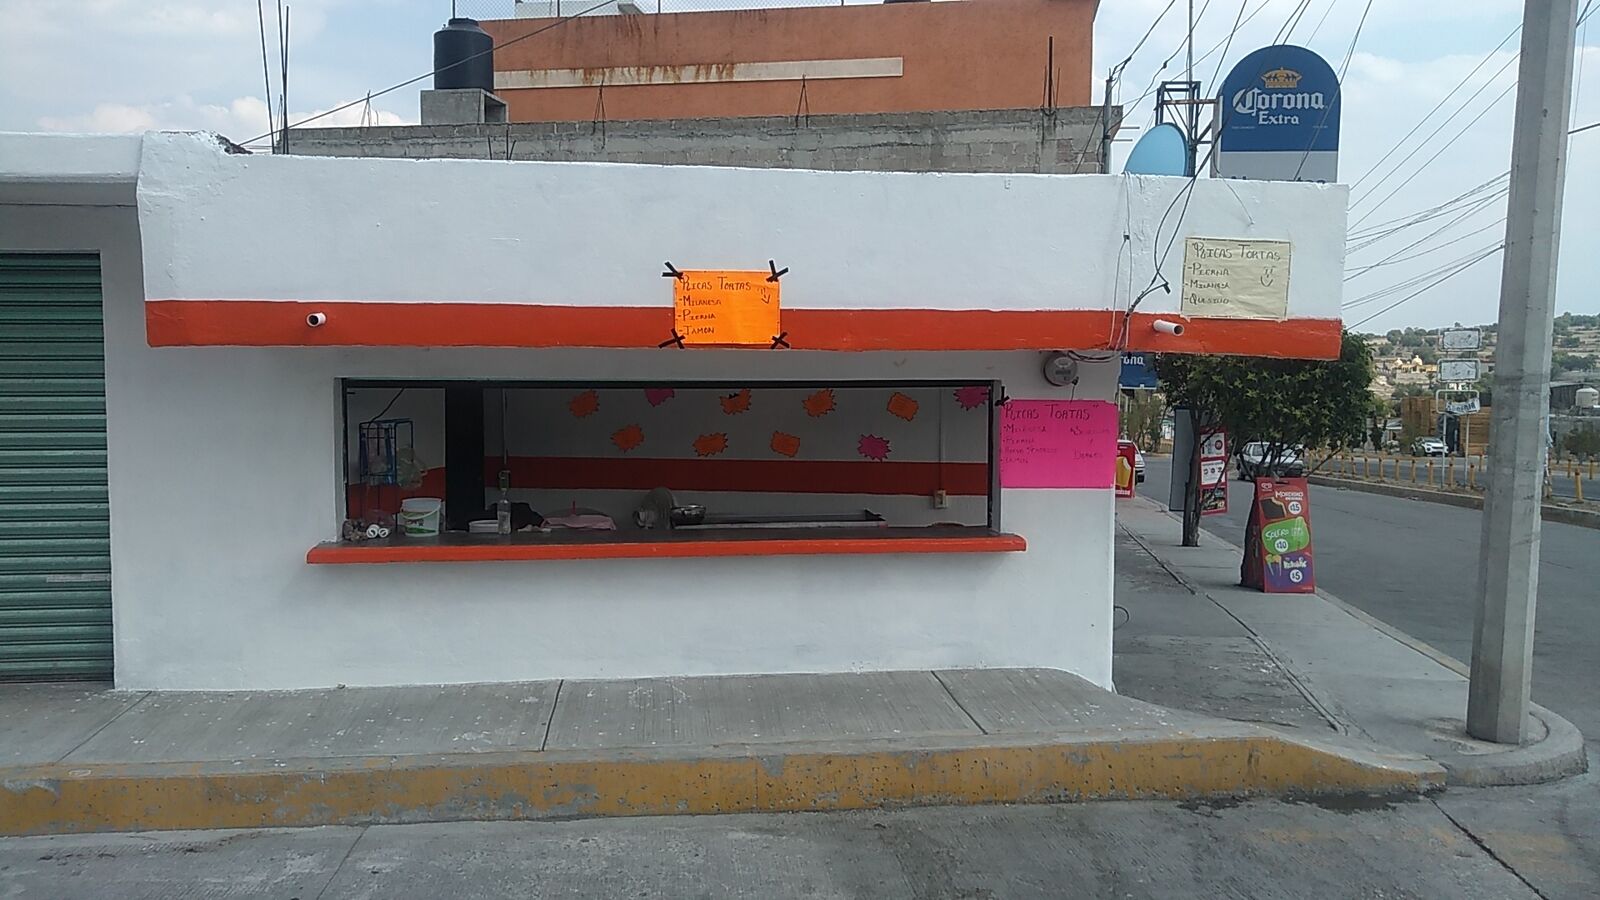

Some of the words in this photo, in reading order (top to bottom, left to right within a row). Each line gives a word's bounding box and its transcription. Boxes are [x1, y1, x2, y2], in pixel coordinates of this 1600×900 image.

[1232, 87, 1325, 116] Corona
[1258, 110, 1300, 124] Extra
[1192, 242, 1232, 259] RICAS
[1238, 244, 1281, 260] TORTAS
[681, 275, 713, 290] RICAS
[717, 276, 752, 290] TORTAS
[1003, 403, 1039, 420] RICAS
[1044, 403, 1090, 420] TORTAS
